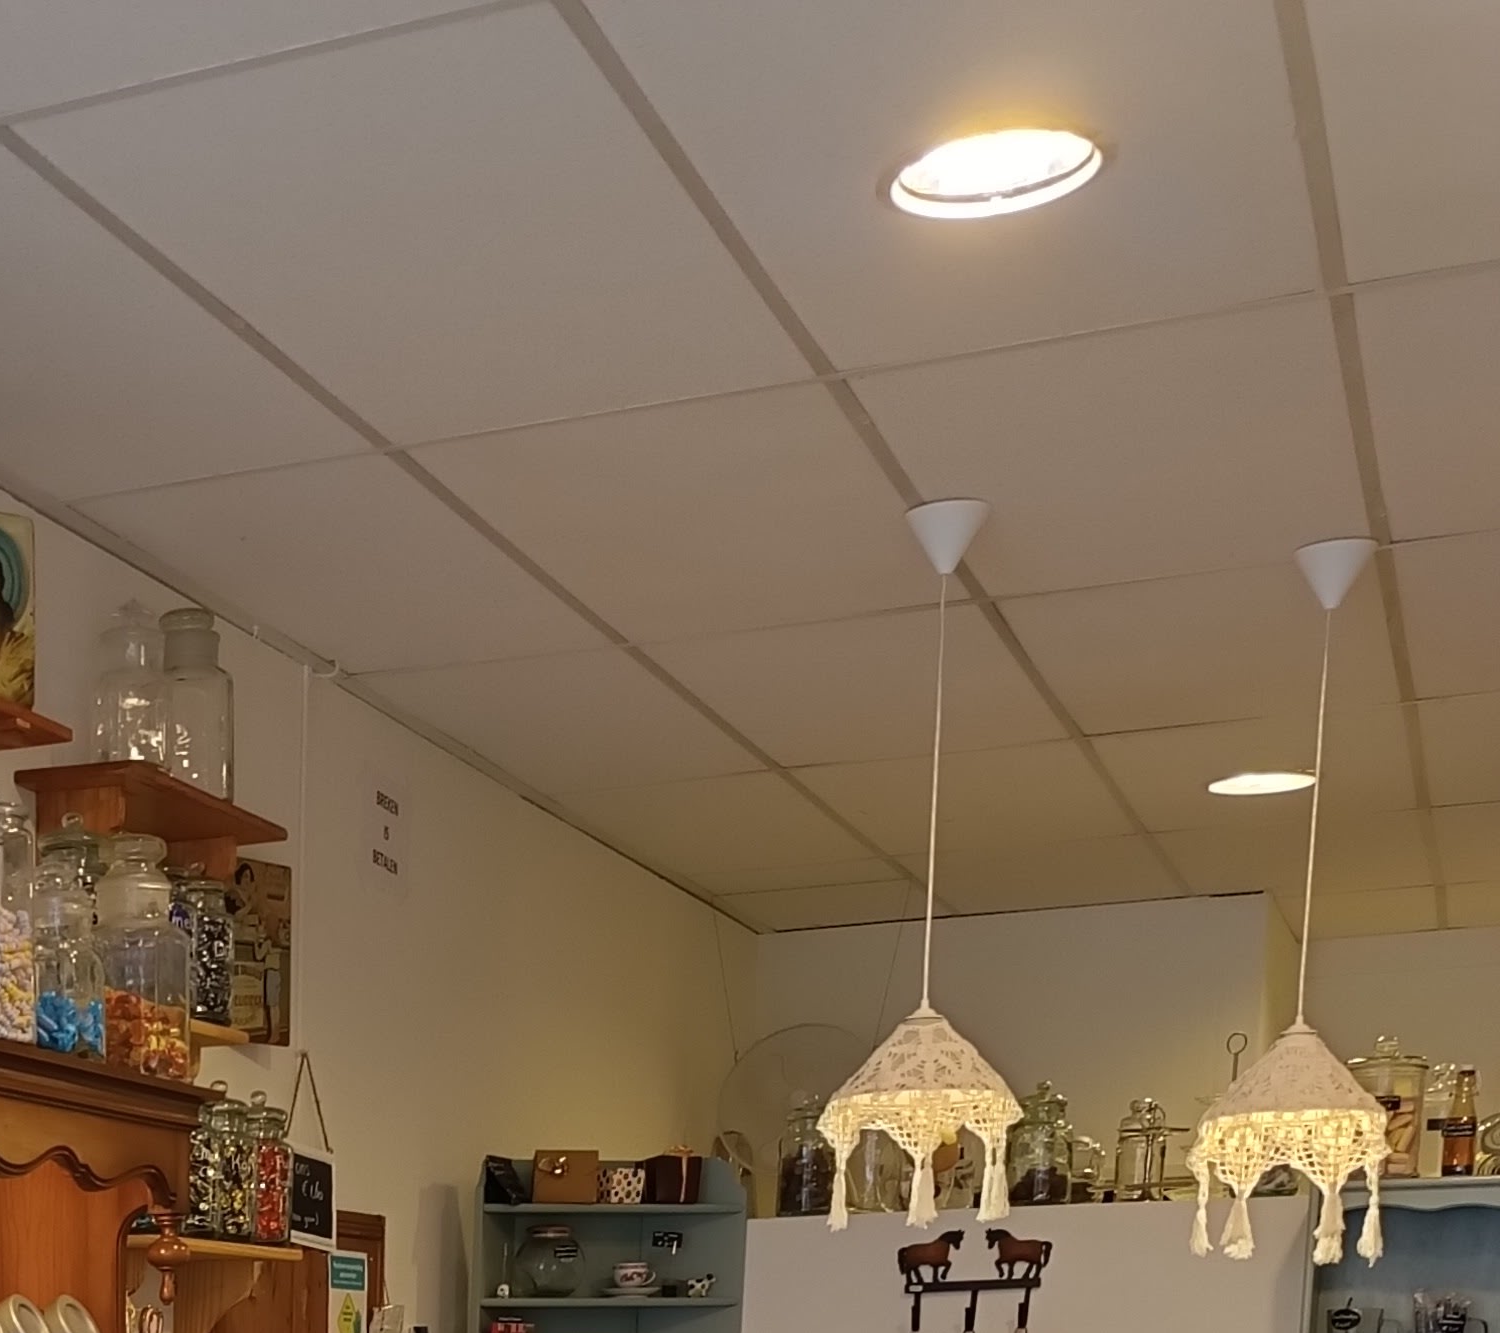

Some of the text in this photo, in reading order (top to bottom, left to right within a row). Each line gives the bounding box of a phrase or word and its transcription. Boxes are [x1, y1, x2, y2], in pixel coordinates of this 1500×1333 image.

[376, 789, 399, 817] BREKEN
[383, 824, 390, 841] IS
[372, 848, 398, 875] BETALEN
